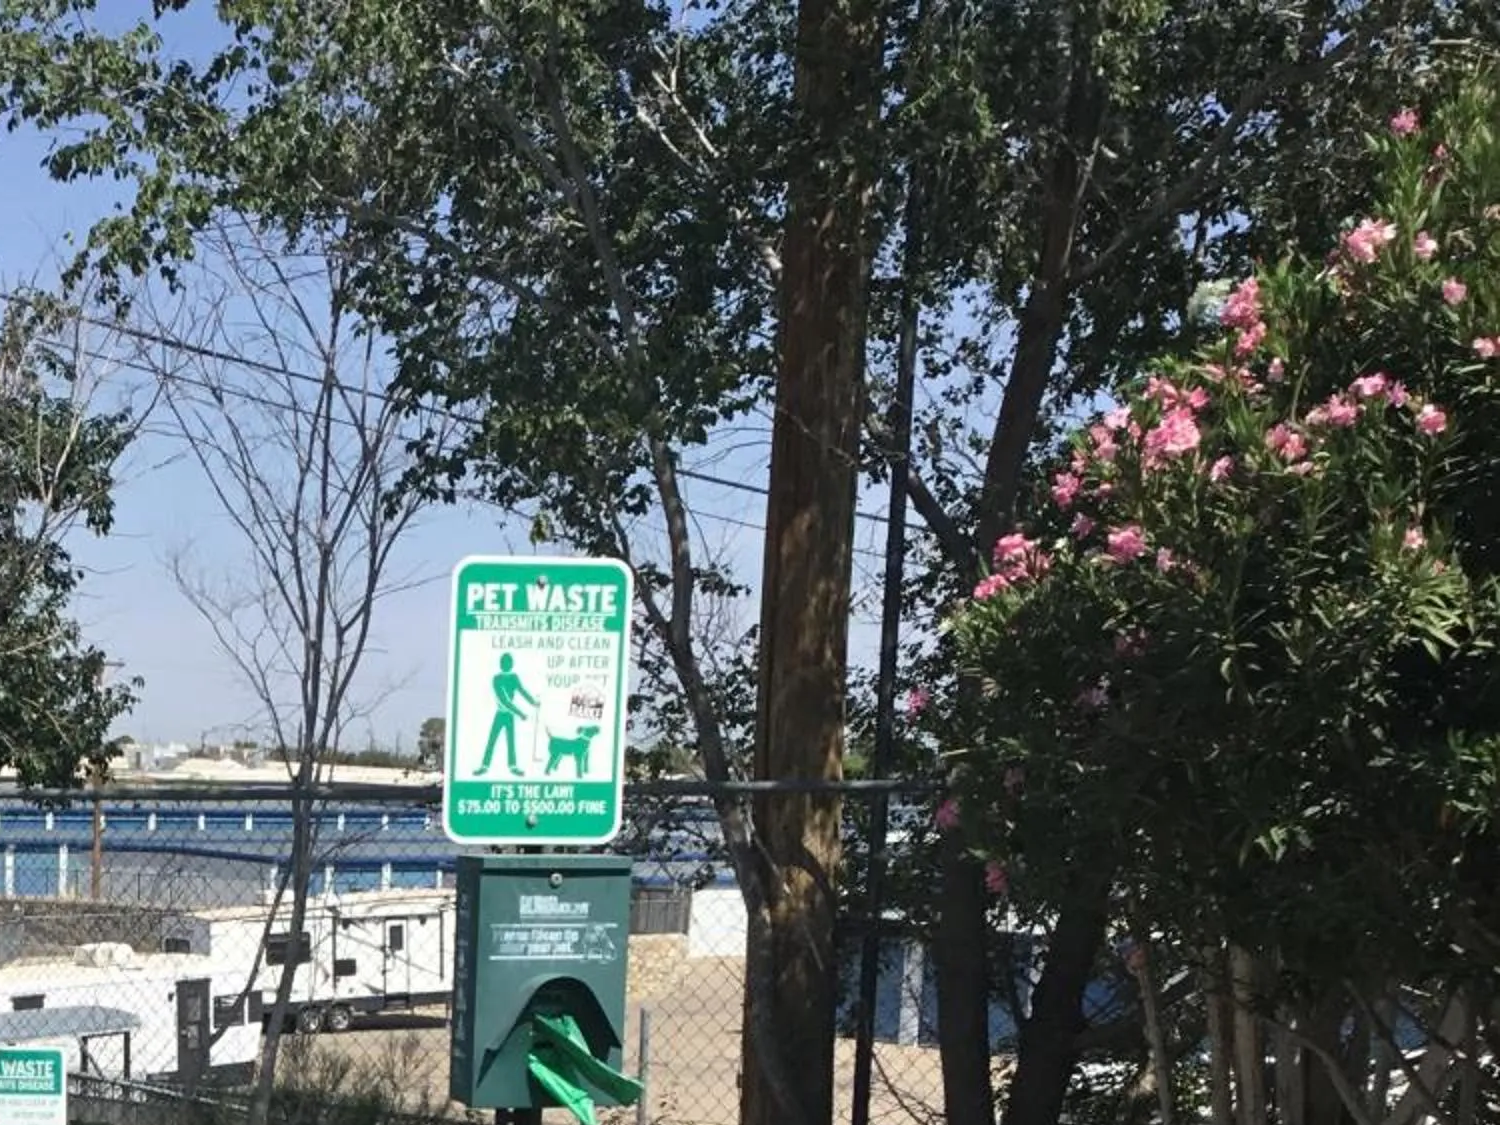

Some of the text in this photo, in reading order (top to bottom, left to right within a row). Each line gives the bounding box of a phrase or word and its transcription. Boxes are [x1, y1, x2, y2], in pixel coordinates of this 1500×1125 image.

[467, 583, 618, 612] PET WASTE
[476, 615, 605, 631] TRANSMITS DISEASE
[491, 635, 611, 650] LEASH AND CLEAN
[547, 655, 610, 669] UP AFTER
[491, 784, 575, 799] IT'S THE LAW!
[458, 799, 607, 815] $75.00 TO $500.00 FINE
[1, 1060, 55, 1076] WASTE
